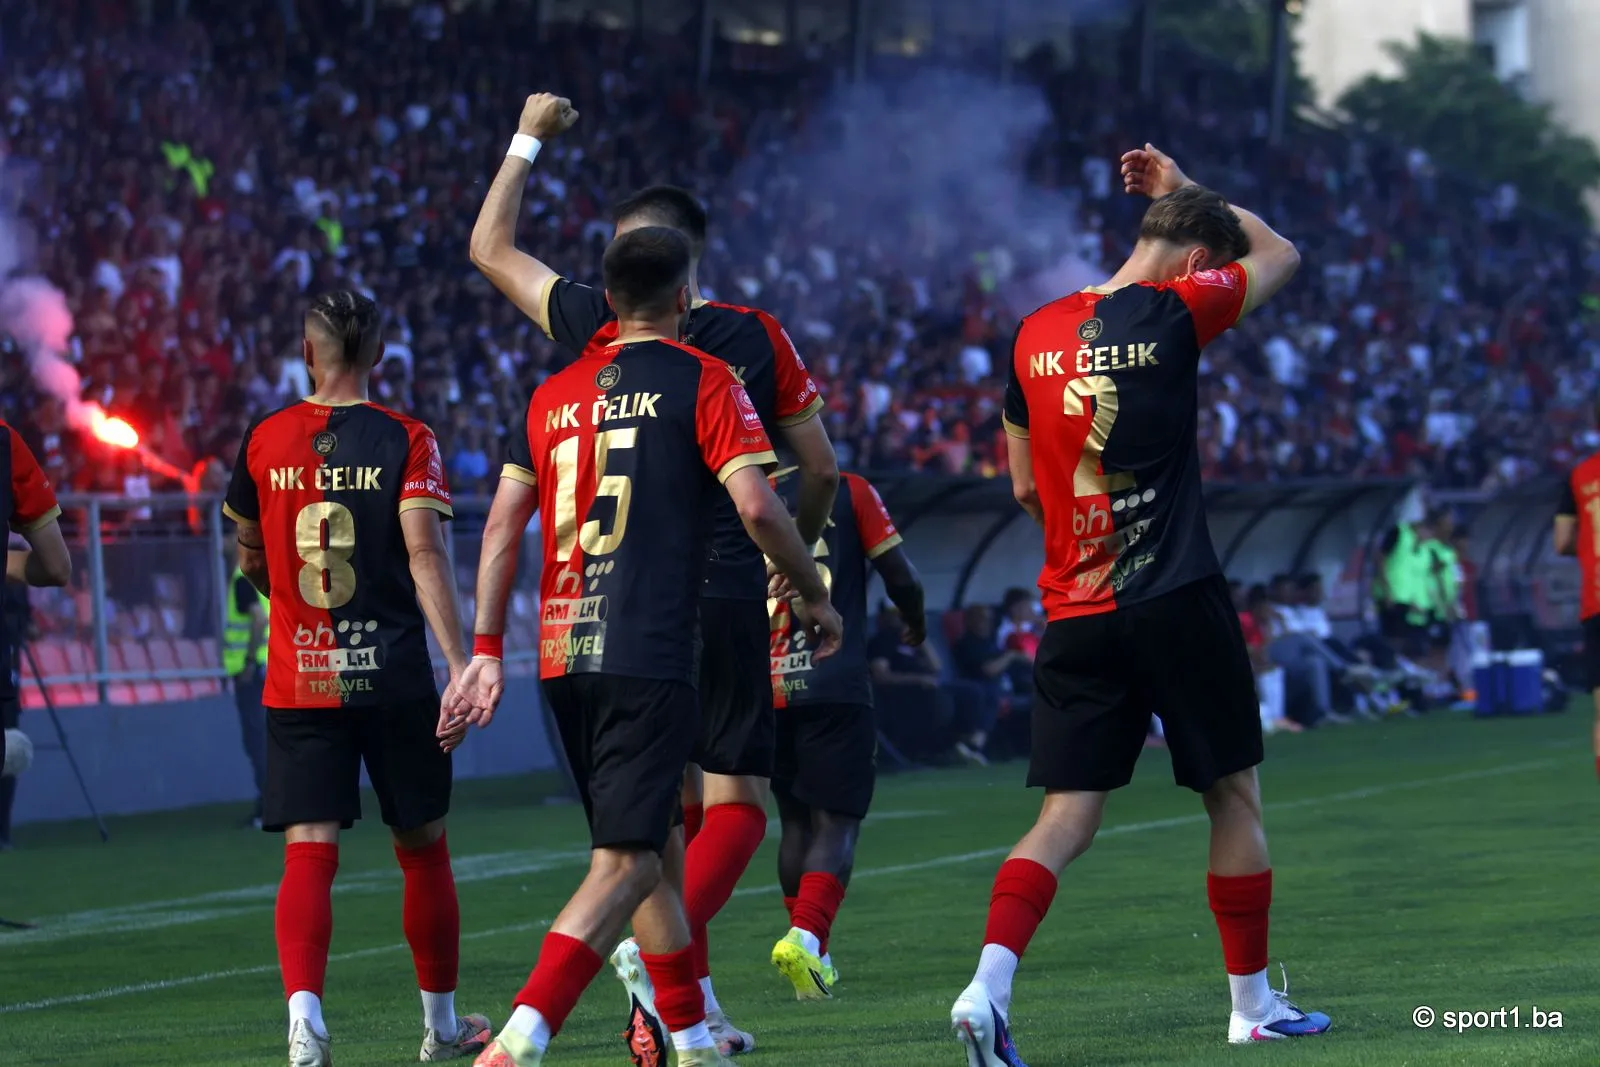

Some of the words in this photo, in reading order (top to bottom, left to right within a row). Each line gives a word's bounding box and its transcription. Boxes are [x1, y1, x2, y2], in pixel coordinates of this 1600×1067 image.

[1030, 351, 1065, 378] NK
[1075, 343, 1160, 373] ČELIK
[545, 403, 580, 432] NK
[592, 391, 662, 426] ČELIK
[1063, 375, 1137, 498] 2
[269, 466, 305, 491] NK
[314, 464, 383, 491] ČELIK
[404, 481, 425, 491] GRAD
[550, 427, 639, 562] 15
[1072, 503, 1108, 536] bh
[295, 502, 356, 609] 8
[293, 621, 335, 647] bh
[309, 674, 374, 693] TRAVEL
